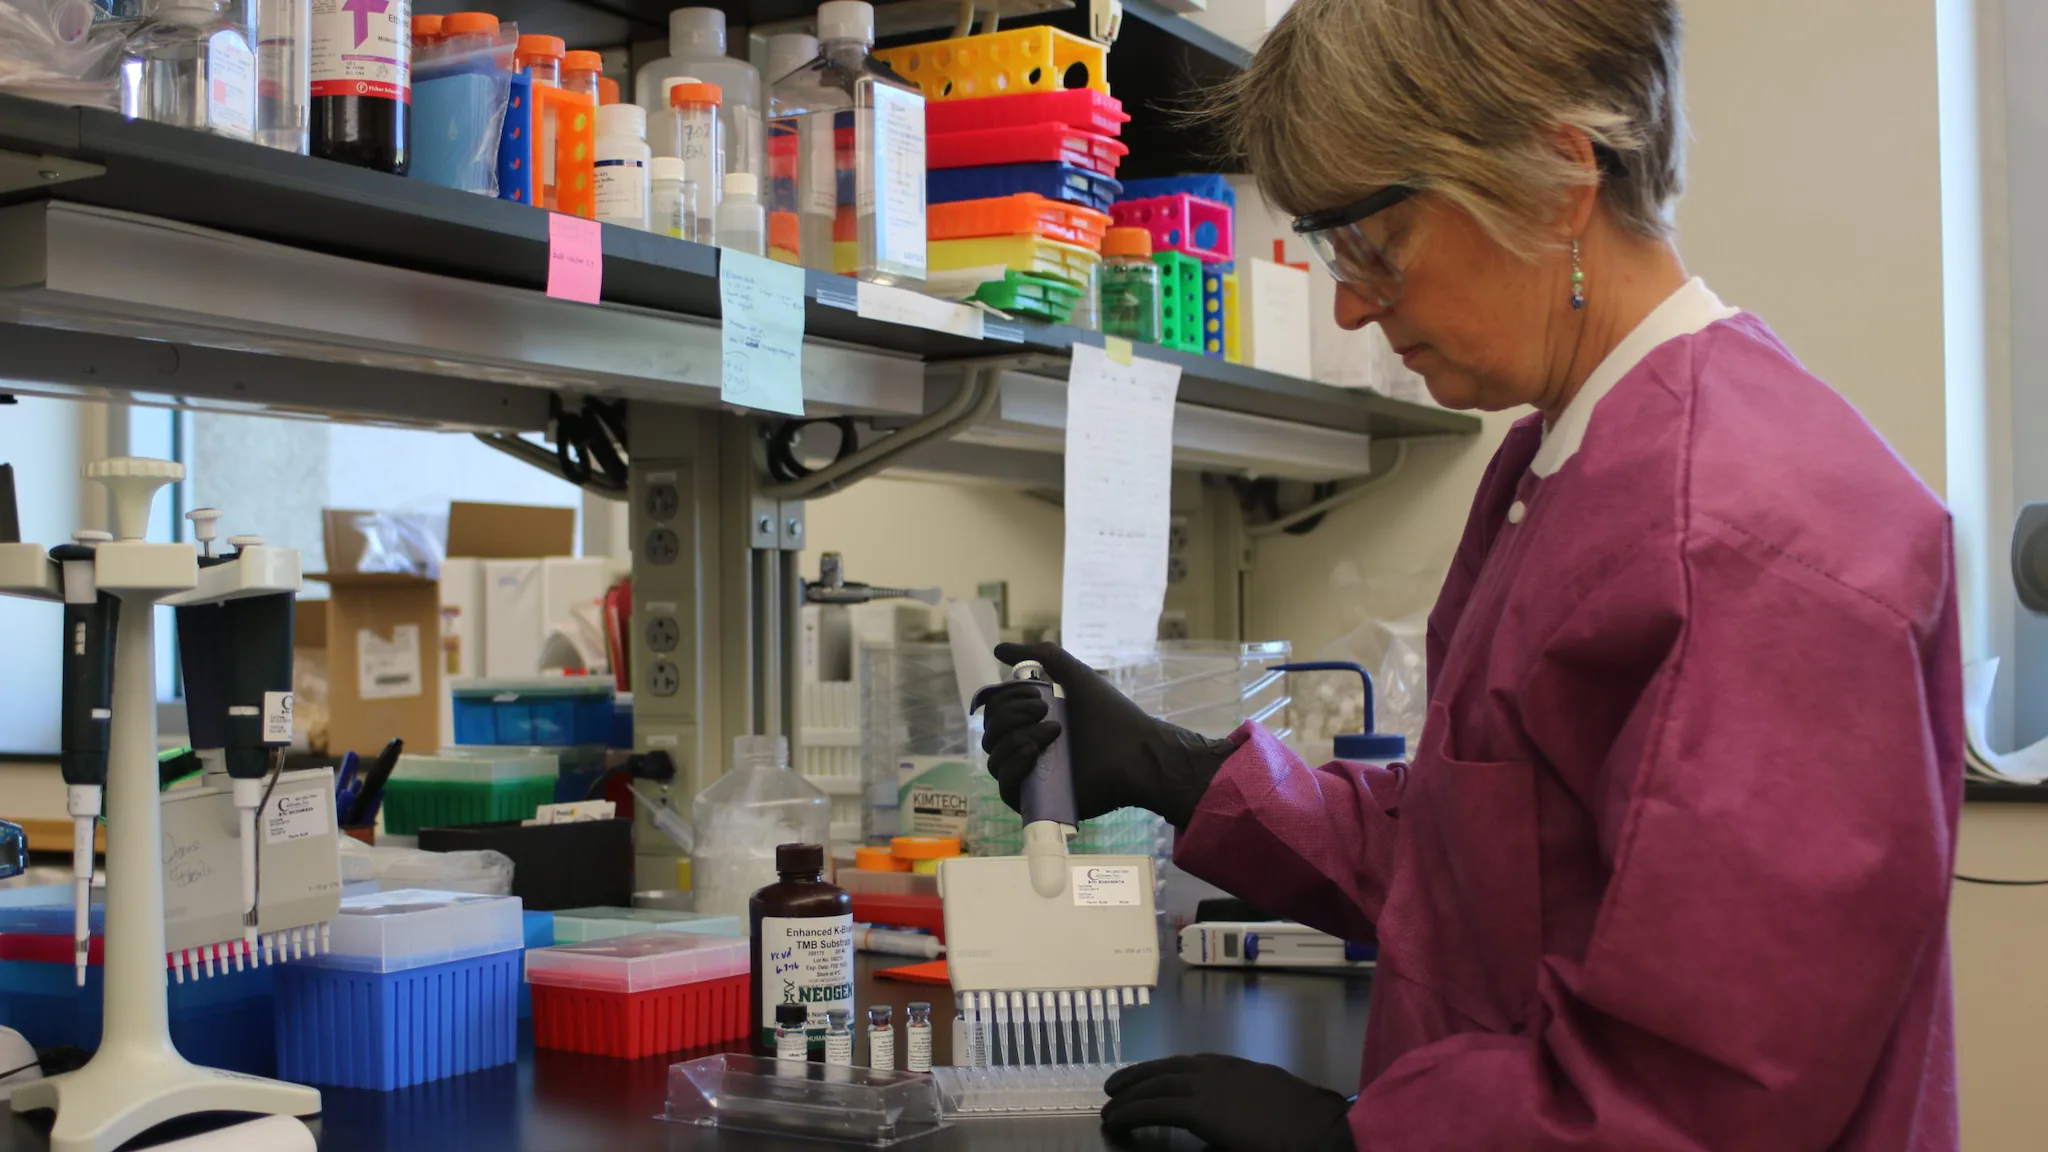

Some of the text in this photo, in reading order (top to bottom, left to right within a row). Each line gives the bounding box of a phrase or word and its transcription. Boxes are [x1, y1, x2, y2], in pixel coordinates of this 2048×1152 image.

[913, 791, 968, 809] KIMTECH
[786, 926, 832, 937] Enhanced
[796, 940, 818, 949] TMB
[798, 982, 853, 1003] NEOGEN
